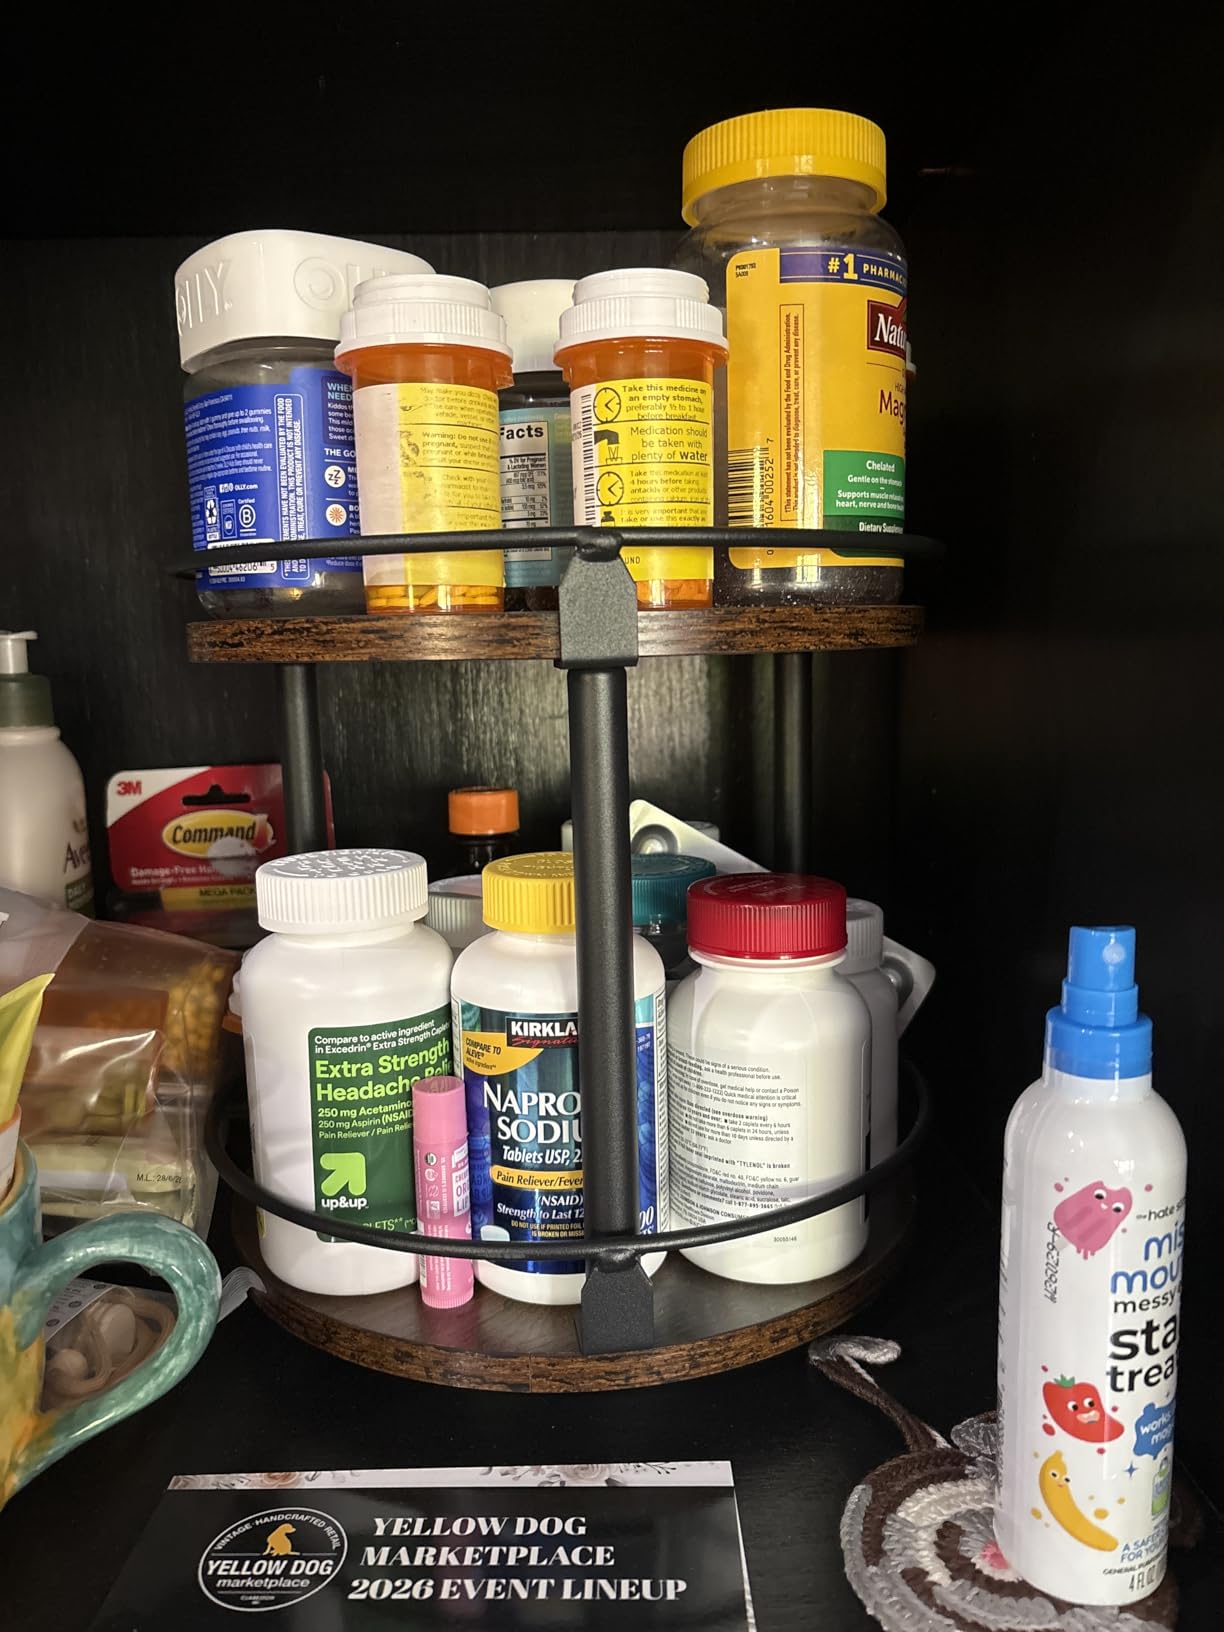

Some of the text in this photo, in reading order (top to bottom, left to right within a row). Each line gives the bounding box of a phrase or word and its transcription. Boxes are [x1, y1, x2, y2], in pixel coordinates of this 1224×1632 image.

[828, 253, 906, 284] #1 PHARMAC
[874, 312, 906, 350] Natu
[784, 355, 792, 368] Drug
[328, 391, 352, 401] NEED
[623, 385, 643, 393] Take
[666, 385, 698, 393] medicine
[328, 402, 347, 410] Kiddos
[626, 403, 667, 412] preferably
[673, 395, 703, 403] stomach,
[879, 389, 906, 426] Mag
[285, 399, 293, 427] INTENDED
[278, 427, 285, 436] BY
[293, 420, 301, 445] DISEASE.
[630, 427, 708, 437] Medication should
[324, 448, 341, 456] THE
[642, 439, 702, 449] be taken with
[279, 437, 287, 470] EVALUATED
[632, 451, 708, 463] plenty of water
[866, 460, 895, 472] Chelated
[847, 474, 870, 483] Gentle
[296, 487, 303, 495] OR
[838, 490, 869, 499] Supports
[281, 500, 289, 515] HAVE
[836, 500, 857, 508] heart,
[859, 522, 882, 532] Dietary
[116, 781, 142, 796] 3M
[172, 821, 257, 844] Command
[314, 1019, 435, 1046] Compare to active ingredient
[511, 1021, 578, 1037] KIRKLA
[315, 1045, 324, 1054] in
[372, 1041, 396, 1051] Extra
[397, 1031, 431, 1046] Strength
[465, 1036, 502, 1056] COMPARE TO
[315, 1038, 450, 1079] Extra Strength
[424, 1057, 452, 1078] Relie
[483, 1080, 582, 1117] NAPRO
[318, 1100, 412, 1119] 250 mg Acetamino
[318, 1120, 335, 1129] 250
[336, 1121, 350, 1130] mg
[351, 1117, 381, 1128] Aspirin
[318, 1121, 414, 1139] Pain Reliever Pain Relie
[496, 1116, 582, 1144] SODIU
[502, 1144, 571, 1165] Tablets USP,
[496, 1171, 584, 1188] Pain Reliever/Fever
[321, 1196, 368, 1211] up&up
[537, 1194, 584, 1207] (NSAID)
[497, 1202, 578, 1220] Strength Last
[1148, 1206, 1175, 1221] hate
[519, 1221, 529, 1229] NOT
[1110, 1254, 1182, 1294] mou
[1113, 1286, 1177, 1313] messy
[1109, 1314, 1178, 1361] sta
[1106, 1354, 1175, 1393] trea
[214, 1513, 337, 1551] VINTAGE HANDCRAFTED RETAIL
[373, 1516, 588, 1536] YELLOW DOG
[359, 1546, 615, 1566] MARKETPLACE
[206, 1559, 334, 1576] YELLOW DOG
[216, 1577, 310, 1589] marketplace
[347, 1578, 688, 1600] 2026 EVENT LINEUP
